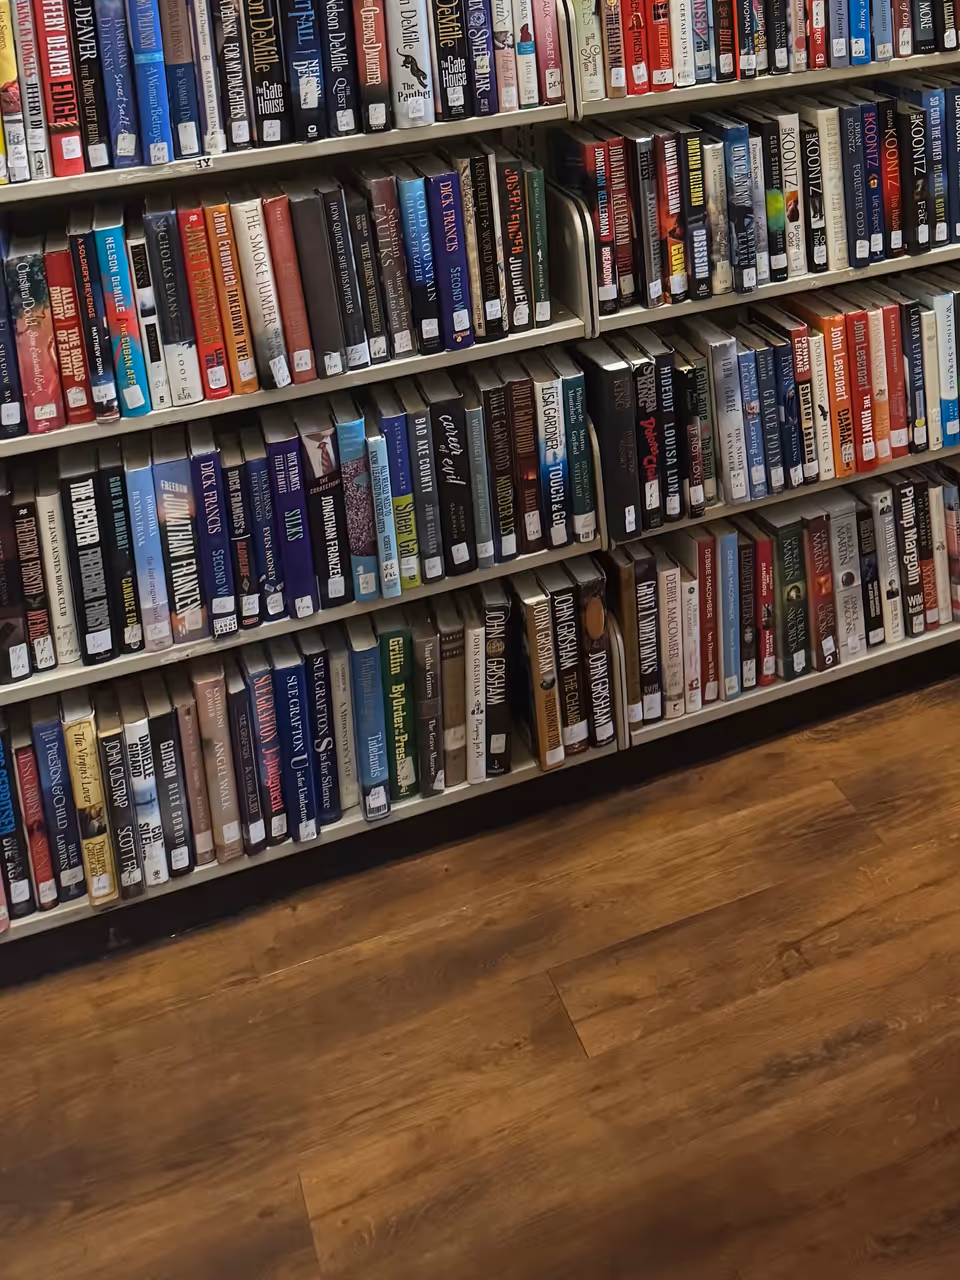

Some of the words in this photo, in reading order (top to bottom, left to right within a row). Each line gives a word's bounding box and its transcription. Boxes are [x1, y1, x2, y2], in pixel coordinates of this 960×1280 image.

[221, 5, 237, 37] DELINSKY
[743, 0, 752, 33] WOMAN
[918, 1, 930, 30] MORE
[46, 37, 71, 76] DEAVER
[224, 43, 239, 59] FOR
[249, 17, 279, 72] DeMille
[226, 61, 239, 73] MY
[51, 82, 78, 122] EDGE
[228, 73, 246, 118] DAUGHTERS
[687, 138, 700, 169] JONATHAN
[806, 138, 822, 196] KOONTZ
[440, 181, 454, 208] DICK
[690, 171, 704, 206] KELLERMAN
[245, 207, 260, 232] THE
[443, 211, 457, 252] FRANCIS
[250, 234, 267, 276] SMOKE
[692, 229, 707, 279] OBSESSION
[49, 286, 64, 319] DRURY
[61, 287, 75, 318] ALLEN
[256, 281, 276, 328] JUMPER
[57, 329, 68, 342] OF
[66, 327, 79, 346] THE
[830, 326, 844, 350] John
[910, 308, 921, 340] LAURA
[59, 343, 72, 376] EARTH
[70, 348, 85, 381] ROADS
[911, 343, 923, 387] LIPPMAN
[659, 366, 673, 413] HIDEOUT
[832, 352, 848, 401] Lescroart
[415, 417, 428, 435] BAD
[417, 440, 430, 455] AXE
[69, 479, 95, 502] THE
[418, 458, 433, 492] COUNTY
[548, 463, 564, 501] TOUCH
[72, 501, 100, 545] DECEIVER
[553, 512, 566, 527] GO
[900, 488, 917, 528] Phillip
[163, 493, 195, 557] JONATHAN
[901, 531, 923, 585] Margolin
[171, 558, 202, 618] FRANZEN
[553, 595, 573, 620] JOHN
[389, 637, 403, 674] Griffin
[556, 622, 578, 670] GRISHAM
[313, 657, 325, 679] SUE
[314, 683, 329, 736] GRAFTON
[73, 732, 87, 746] The
[103, 740, 123, 767] JOHN
[313, 737, 333, 752] S
[367, 732, 382, 777] Tidelands
[46, 742, 62, 786] PRESTON
[75, 748, 92, 780] Virgin's
[128, 743, 142, 778] GIRARD
[138, 734, 154, 779] DANIELLE
[320, 753, 328, 761] is
[320, 762, 330, 774] for
[52, 786, 63, 796] &
[79, 782, 93, 804] Lover
[108, 767, 128, 808] GILSTRAP
[321, 776, 333, 808] Silence
[53, 796, 68, 829] CHILD
